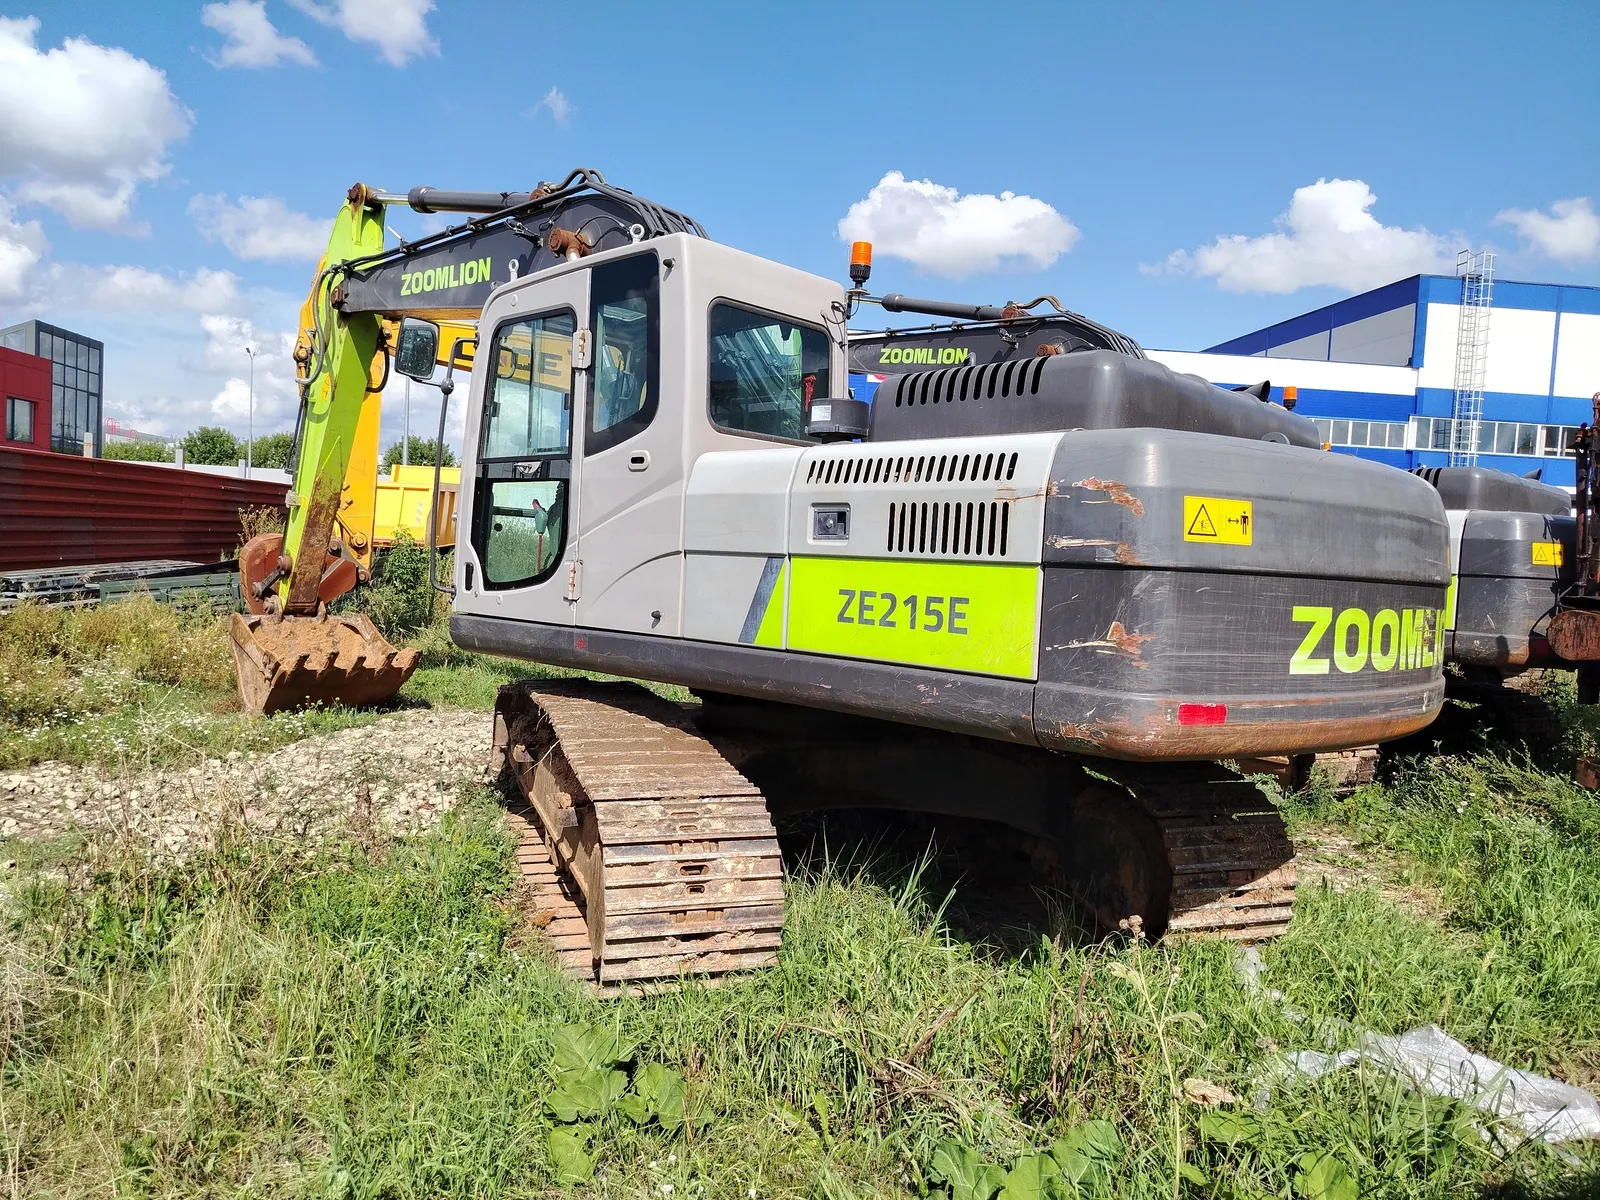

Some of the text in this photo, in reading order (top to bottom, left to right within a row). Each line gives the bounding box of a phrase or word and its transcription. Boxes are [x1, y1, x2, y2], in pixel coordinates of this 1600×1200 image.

[400, 257, 492, 297] ZOOMLION
[879, 347, 969, 365] ZOOMLION
[837, 588, 970, 635] ZE215E
